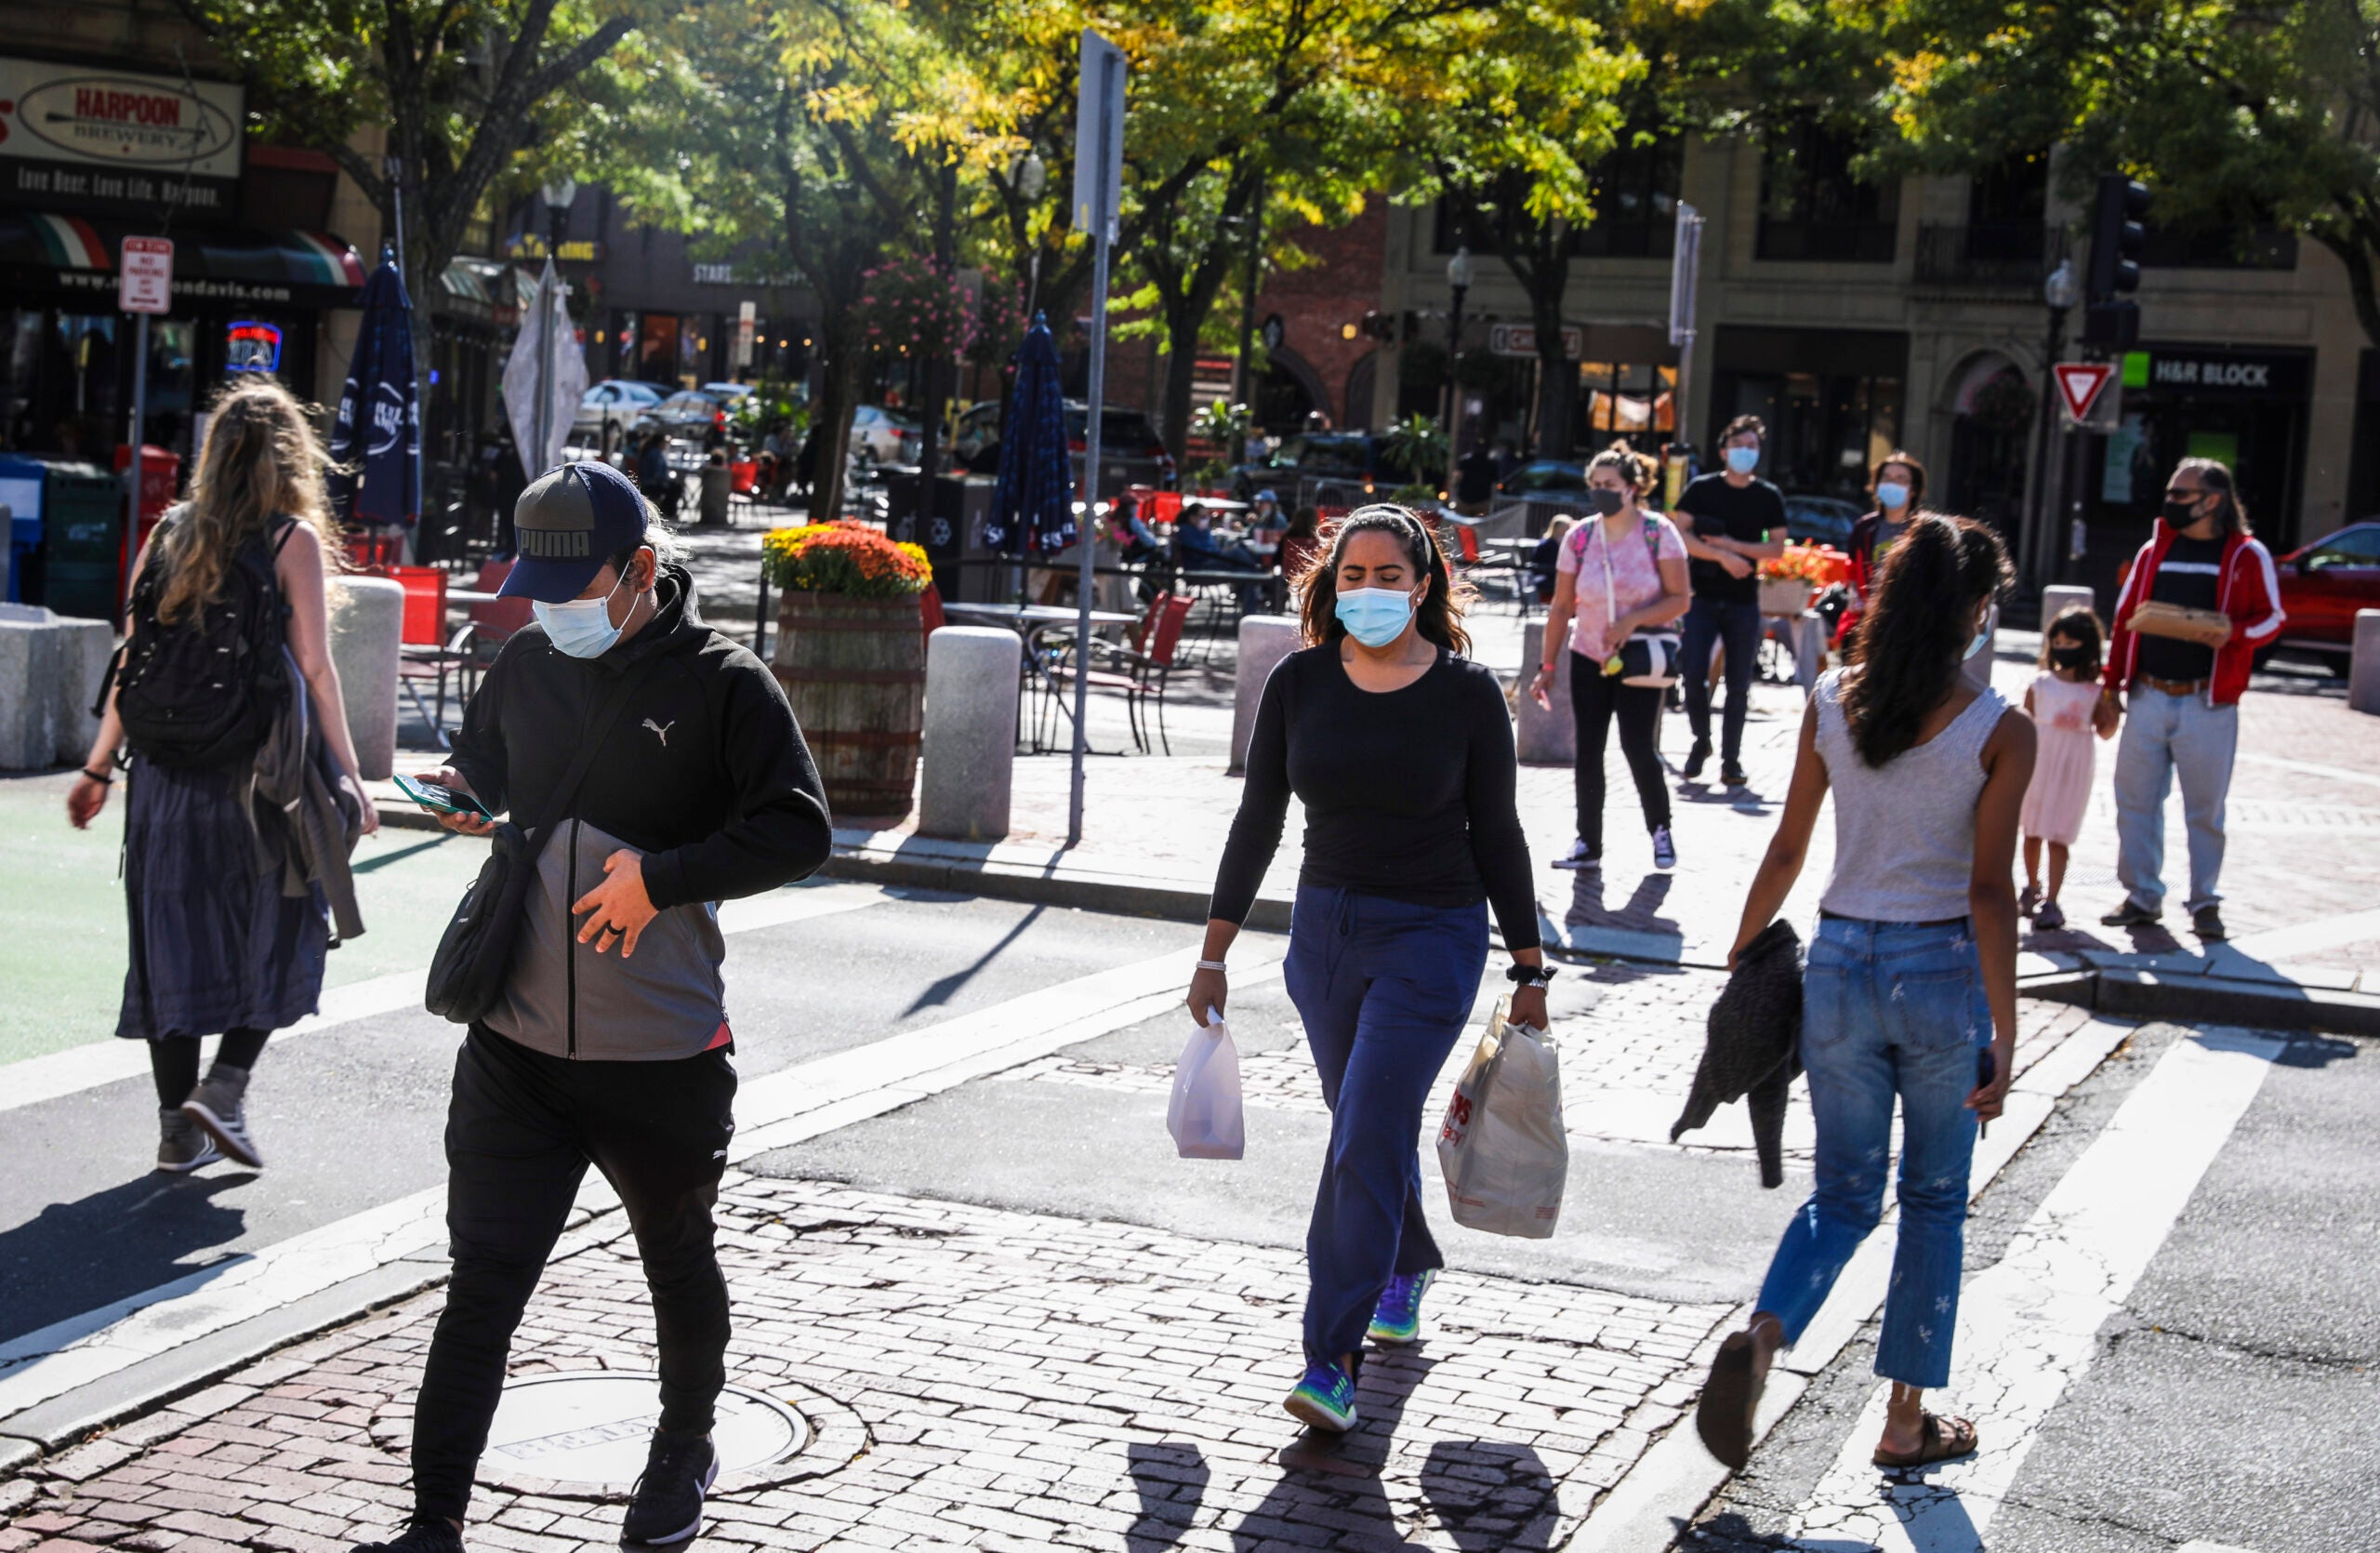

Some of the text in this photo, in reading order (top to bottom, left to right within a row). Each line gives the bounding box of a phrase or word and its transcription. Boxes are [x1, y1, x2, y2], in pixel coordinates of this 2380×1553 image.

[76, 88, 180, 126] HARPOON
[74, 126, 178, 148] BREWERY
[18, 166, 49, 192] Love
[53, 169, 89, 194] Beer.
[93, 173, 125, 199] Love
[127, 176, 157, 201] Life.
[2155, 359, 2269, 388] H&R BLOCK
[520, 528, 590, 557] PUMA
